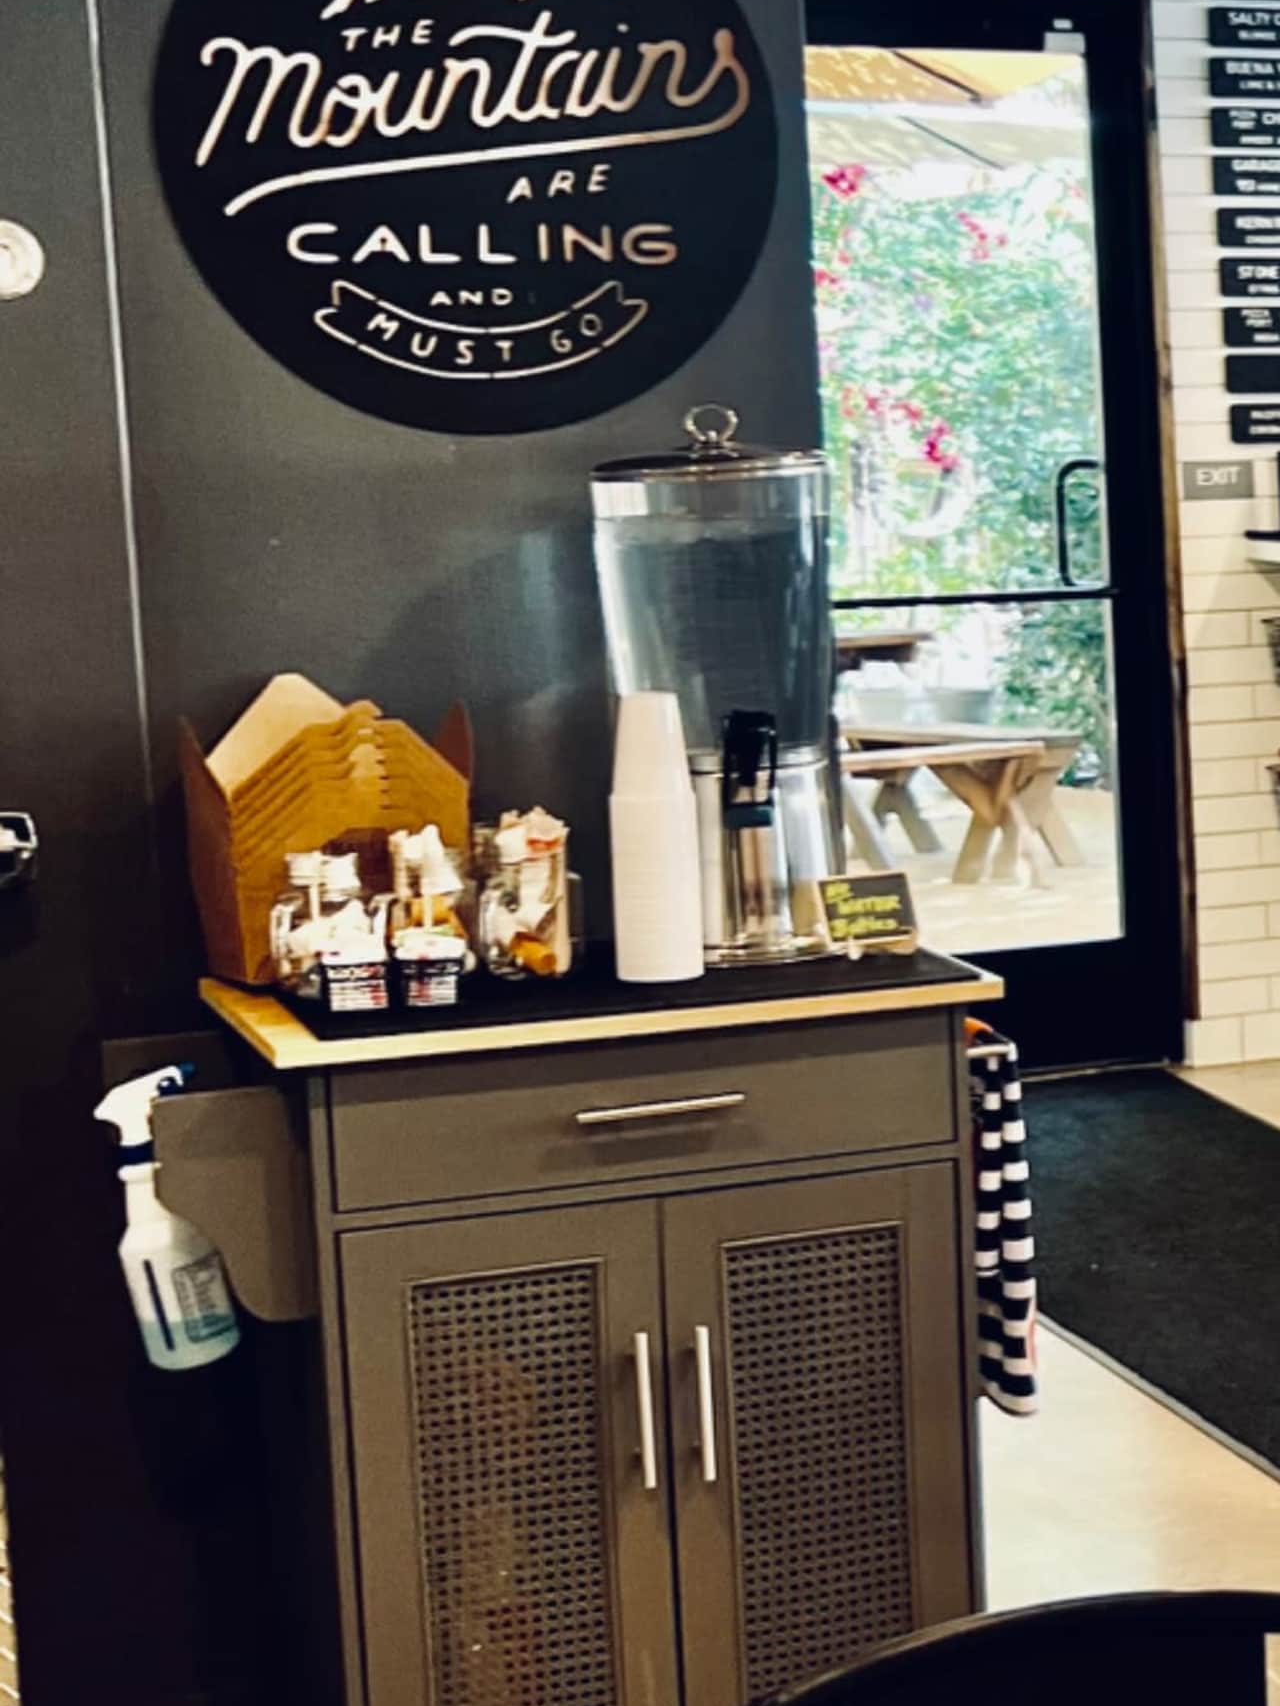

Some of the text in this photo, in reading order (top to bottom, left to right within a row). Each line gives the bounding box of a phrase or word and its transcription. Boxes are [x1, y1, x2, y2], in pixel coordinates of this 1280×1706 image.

[341, 18, 435, 52] THE
[1228, 11, 1271, 26] SALTY
[195, 9, 750, 169] Mountains
[506, 163, 612, 204] ARE
[286, 223, 679, 266] CALLING
[429, 289, 515, 307] AND
[366, 313, 604, 365] MUST GO
[1196, 466, 1242, 486] EXIT
